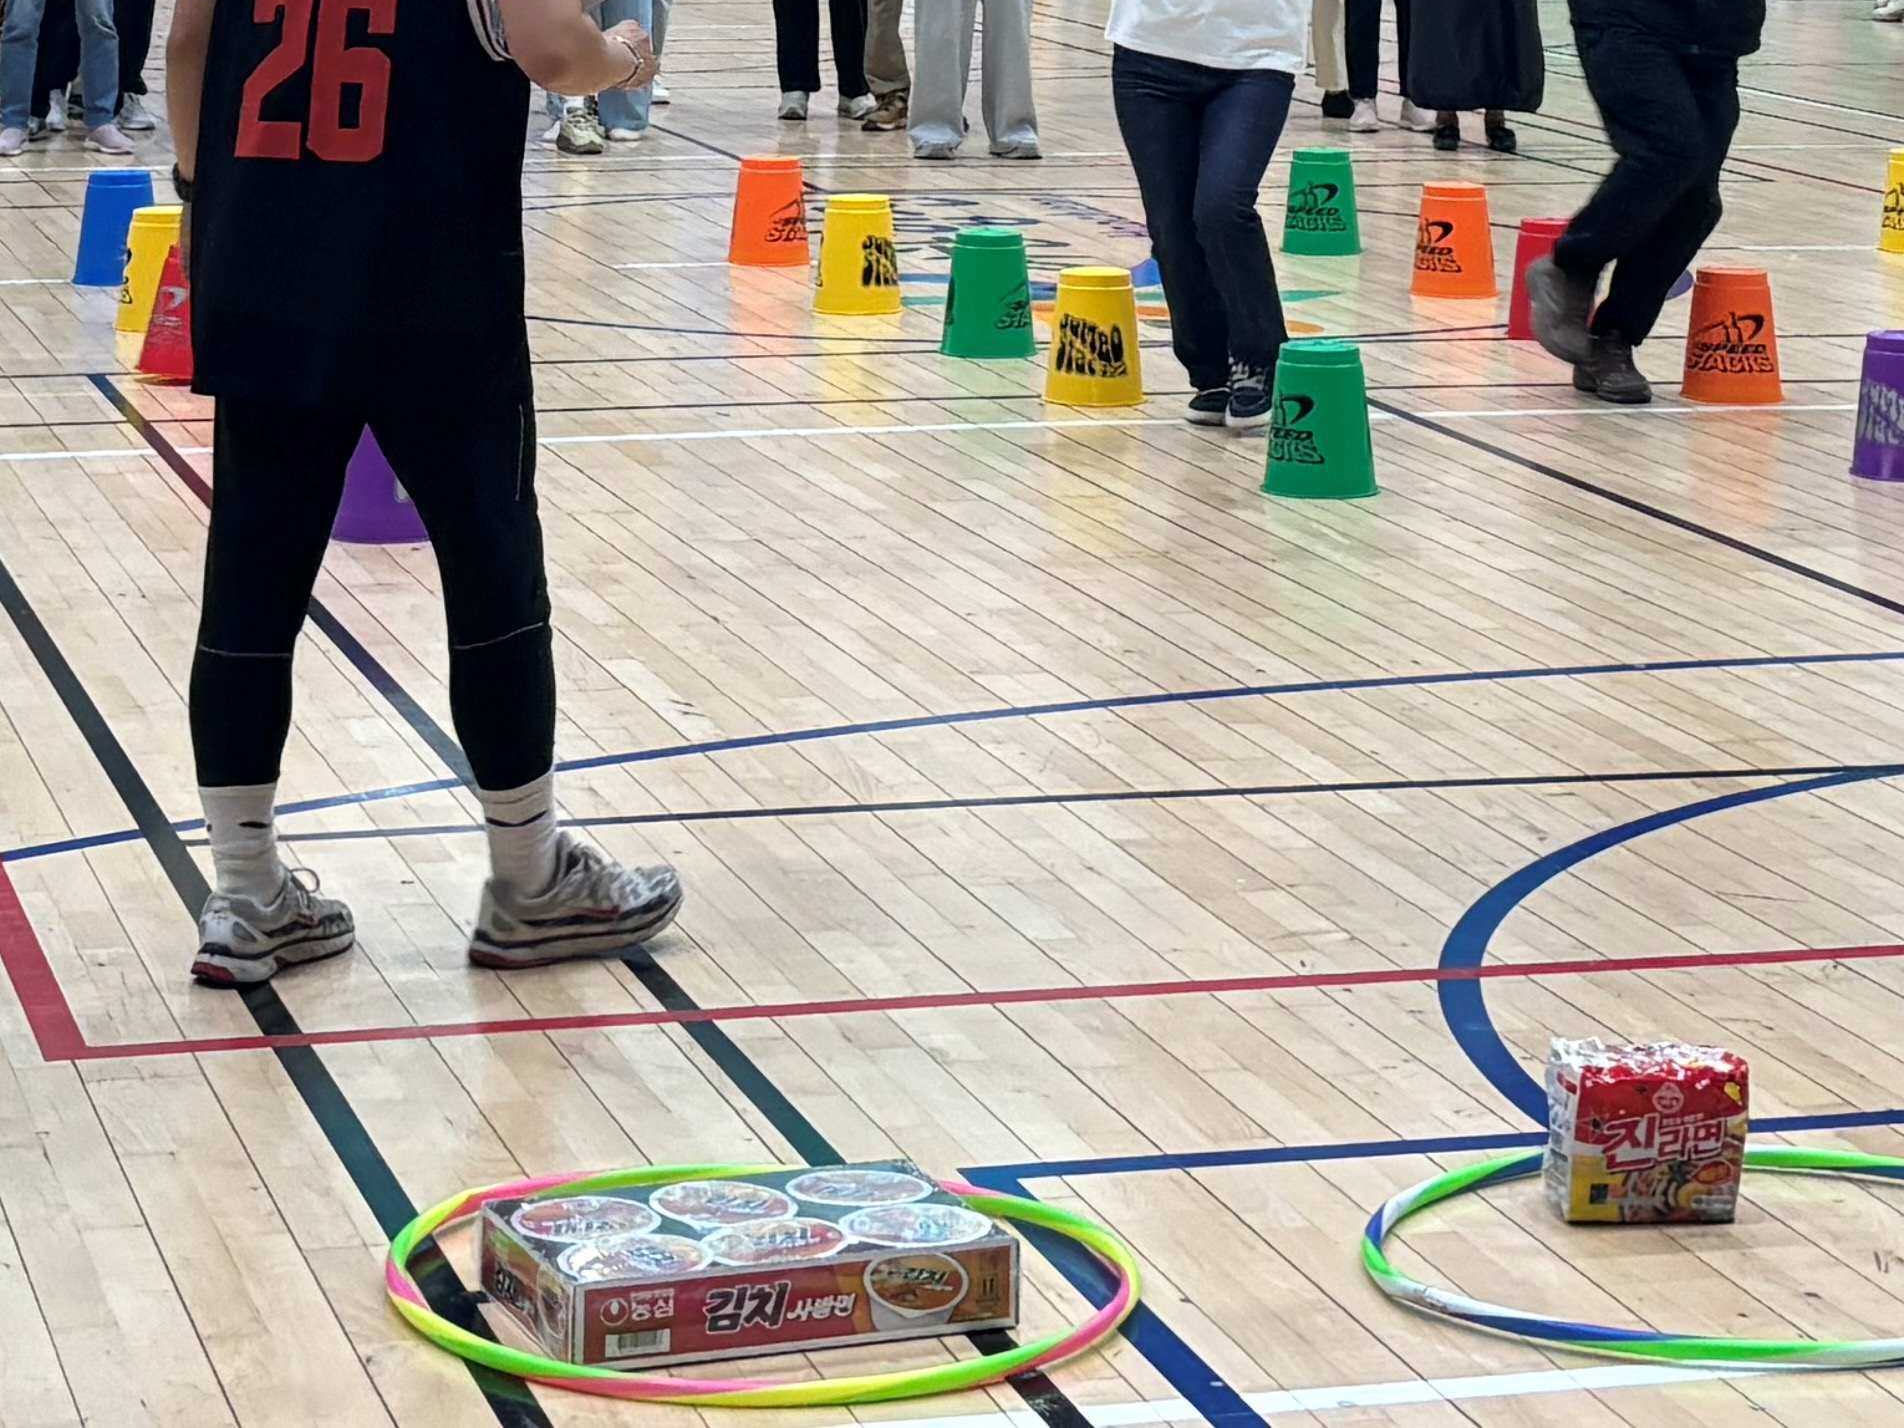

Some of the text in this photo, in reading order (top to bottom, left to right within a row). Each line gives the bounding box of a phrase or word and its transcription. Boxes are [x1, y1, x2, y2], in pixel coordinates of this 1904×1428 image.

[1604, 1114, 1727, 1172] 진라면
[630, 1299, 675, 1321] 농심
[703, 1280, 857, 1334] 김치 사발면
